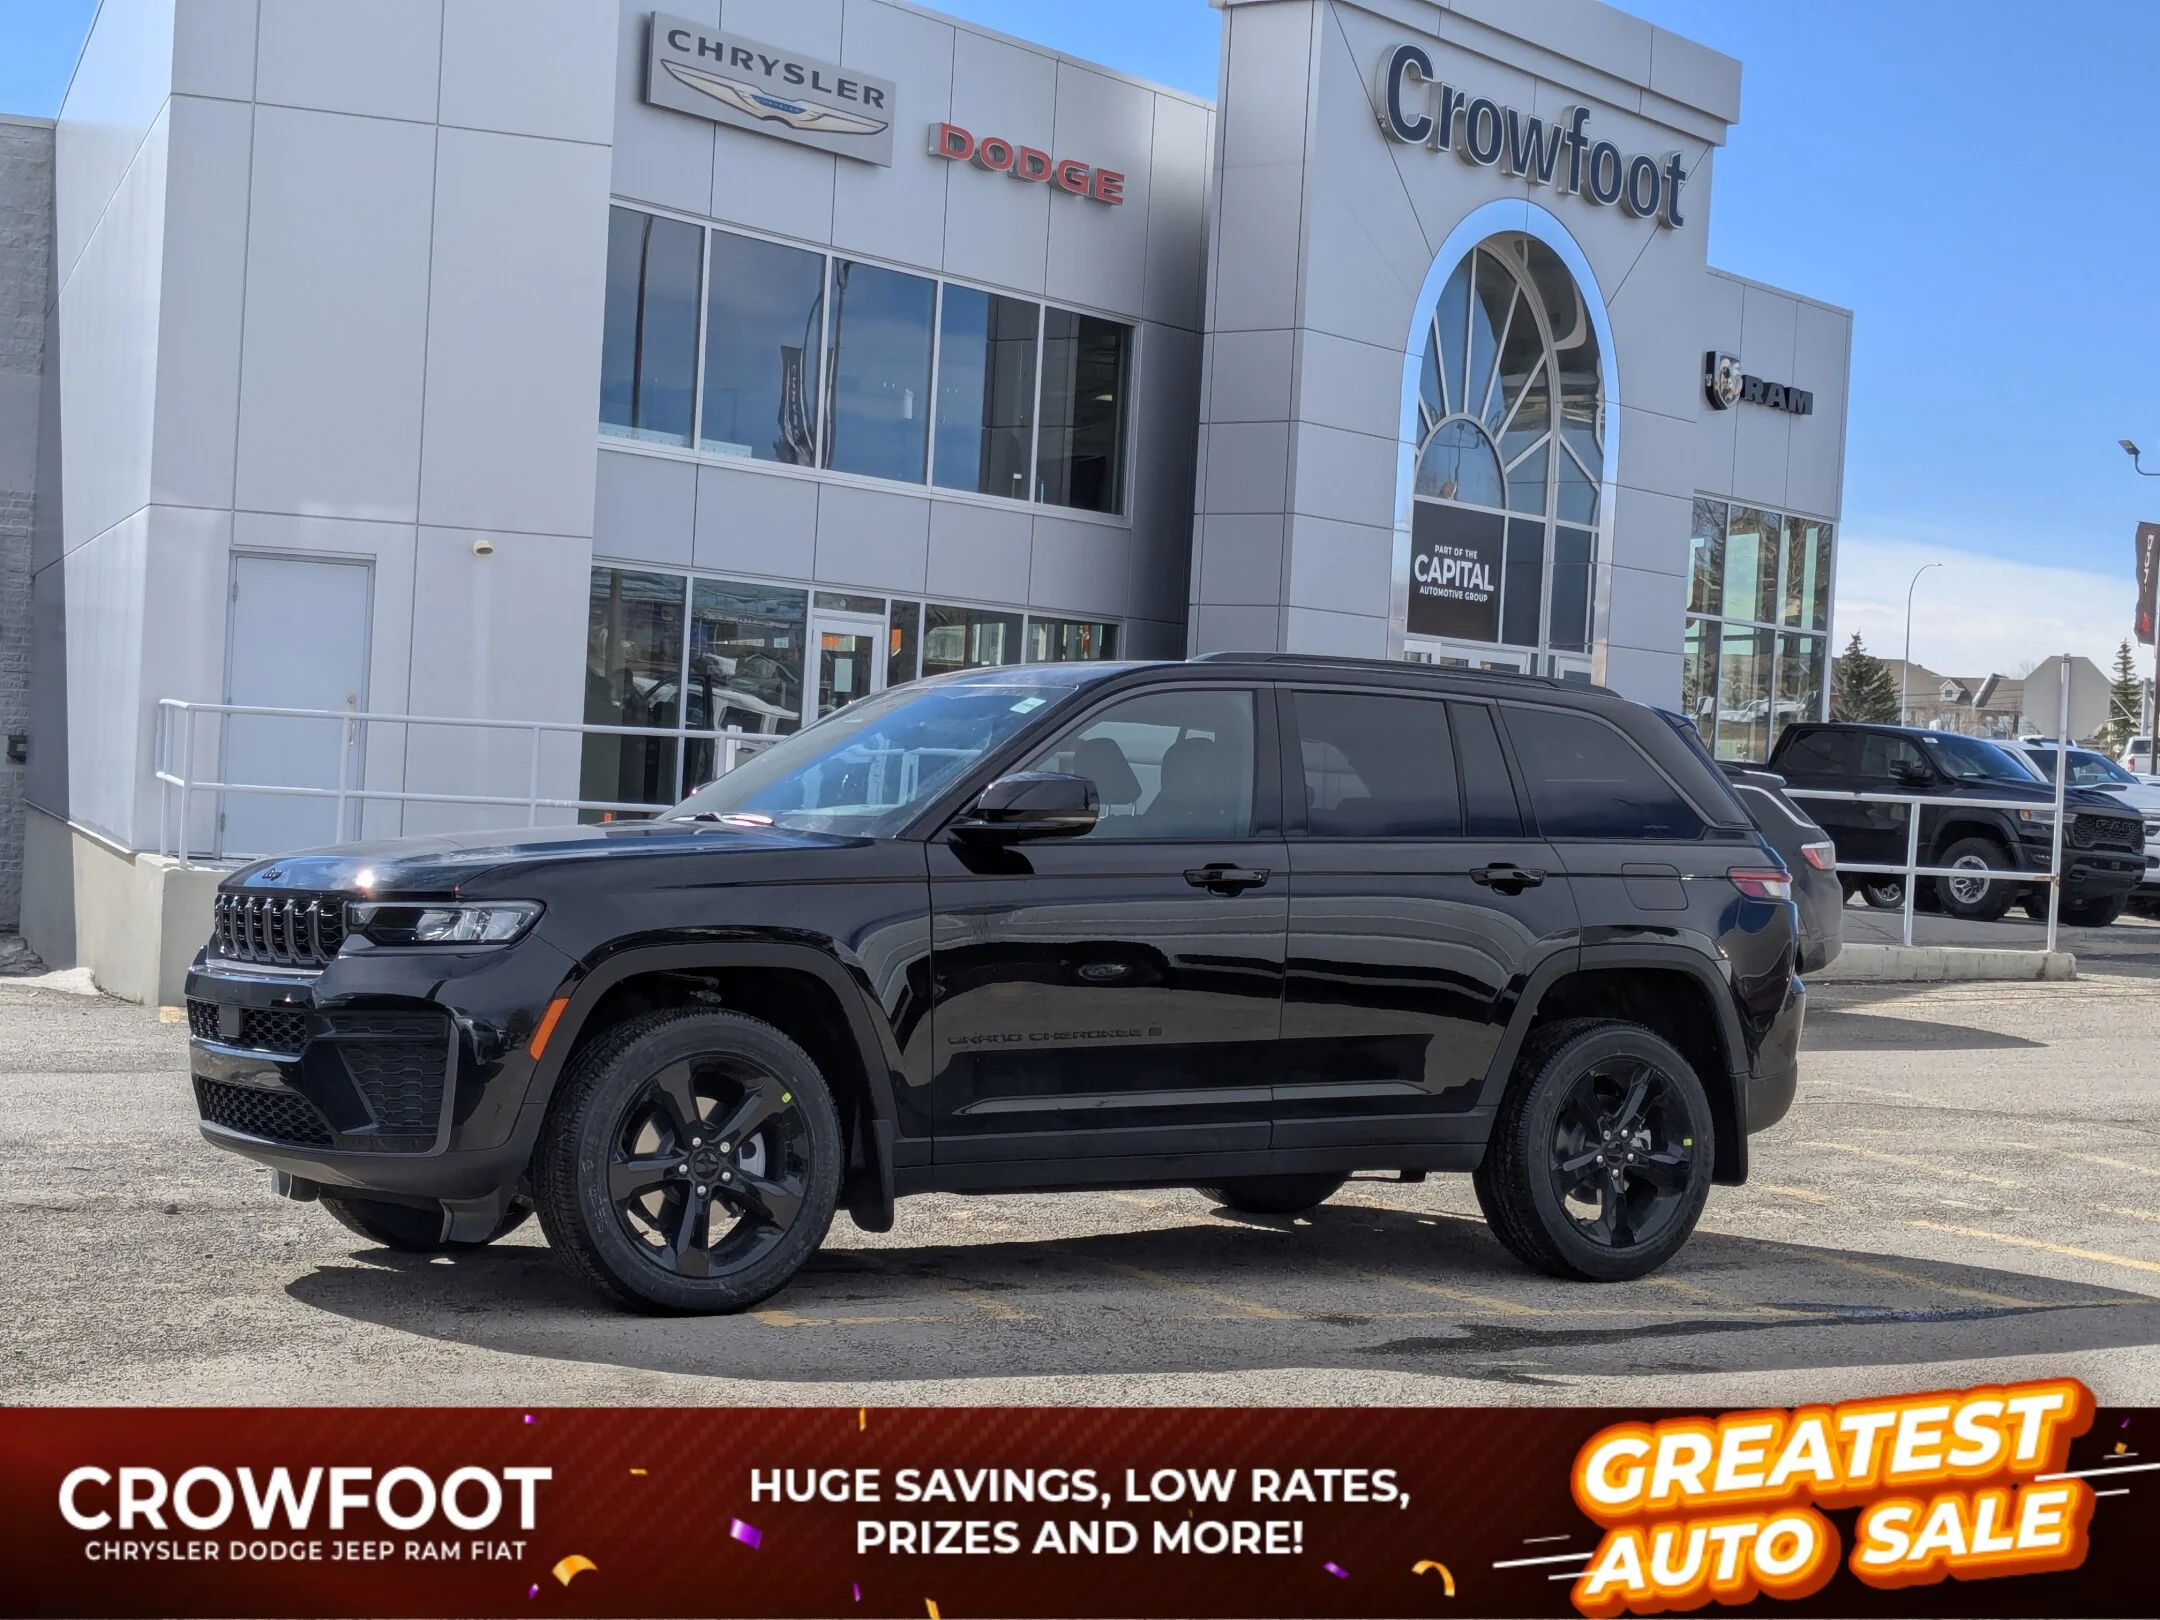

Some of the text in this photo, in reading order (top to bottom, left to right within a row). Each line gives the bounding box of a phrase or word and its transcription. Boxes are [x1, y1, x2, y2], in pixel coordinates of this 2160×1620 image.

[667, 29, 885, 109] CHRYSLER
[1383, 43, 1688, 230] Crowfoot
[939, 122, 1125, 205] DODGE
[1742, 374, 1814, 415] RAM
[1434, 544, 1478, 560] PART OF THE
[1414, 554, 1494, 592] CAPITAL
[1419, 585, 1488, 603] AUTOMOTIVE GROUP
